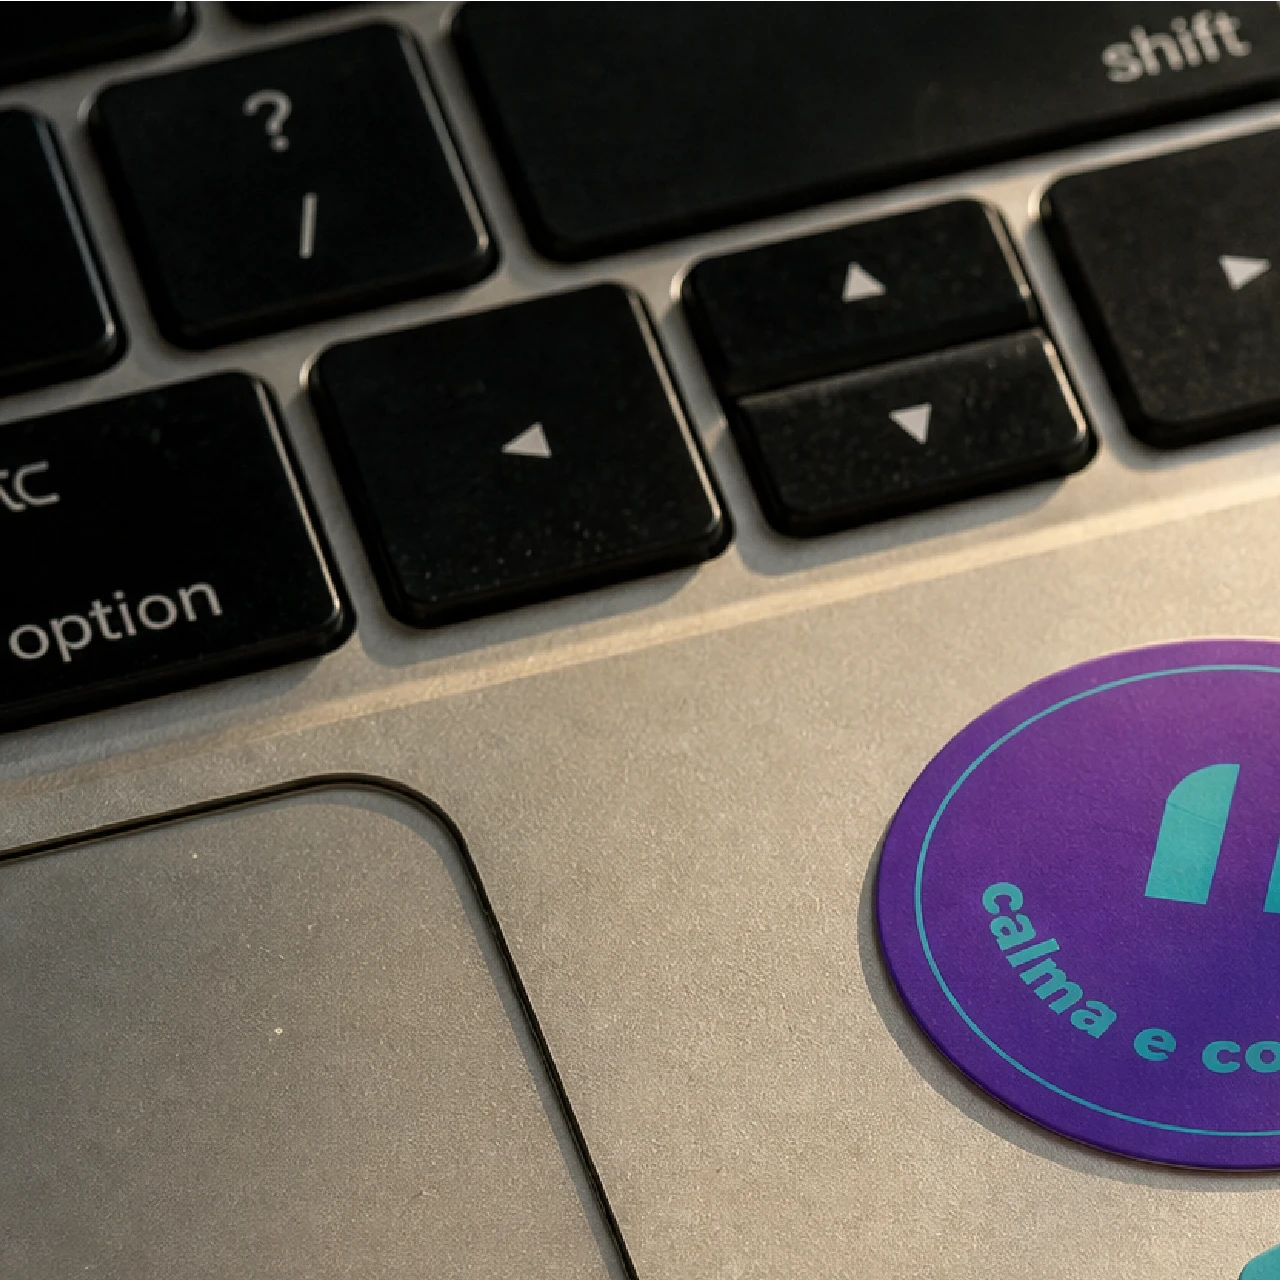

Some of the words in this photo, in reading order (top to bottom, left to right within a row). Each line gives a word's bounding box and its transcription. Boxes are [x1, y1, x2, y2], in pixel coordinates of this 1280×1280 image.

[1102, 9, 1251, 82] shift
[243, 89, 292, 152] ?
[299, 193, 317, 258] /
[8, 582, 223, 662] option
[982, 881, 1118, 1038] calma
[1133, 1027, 1177, 1062] e
